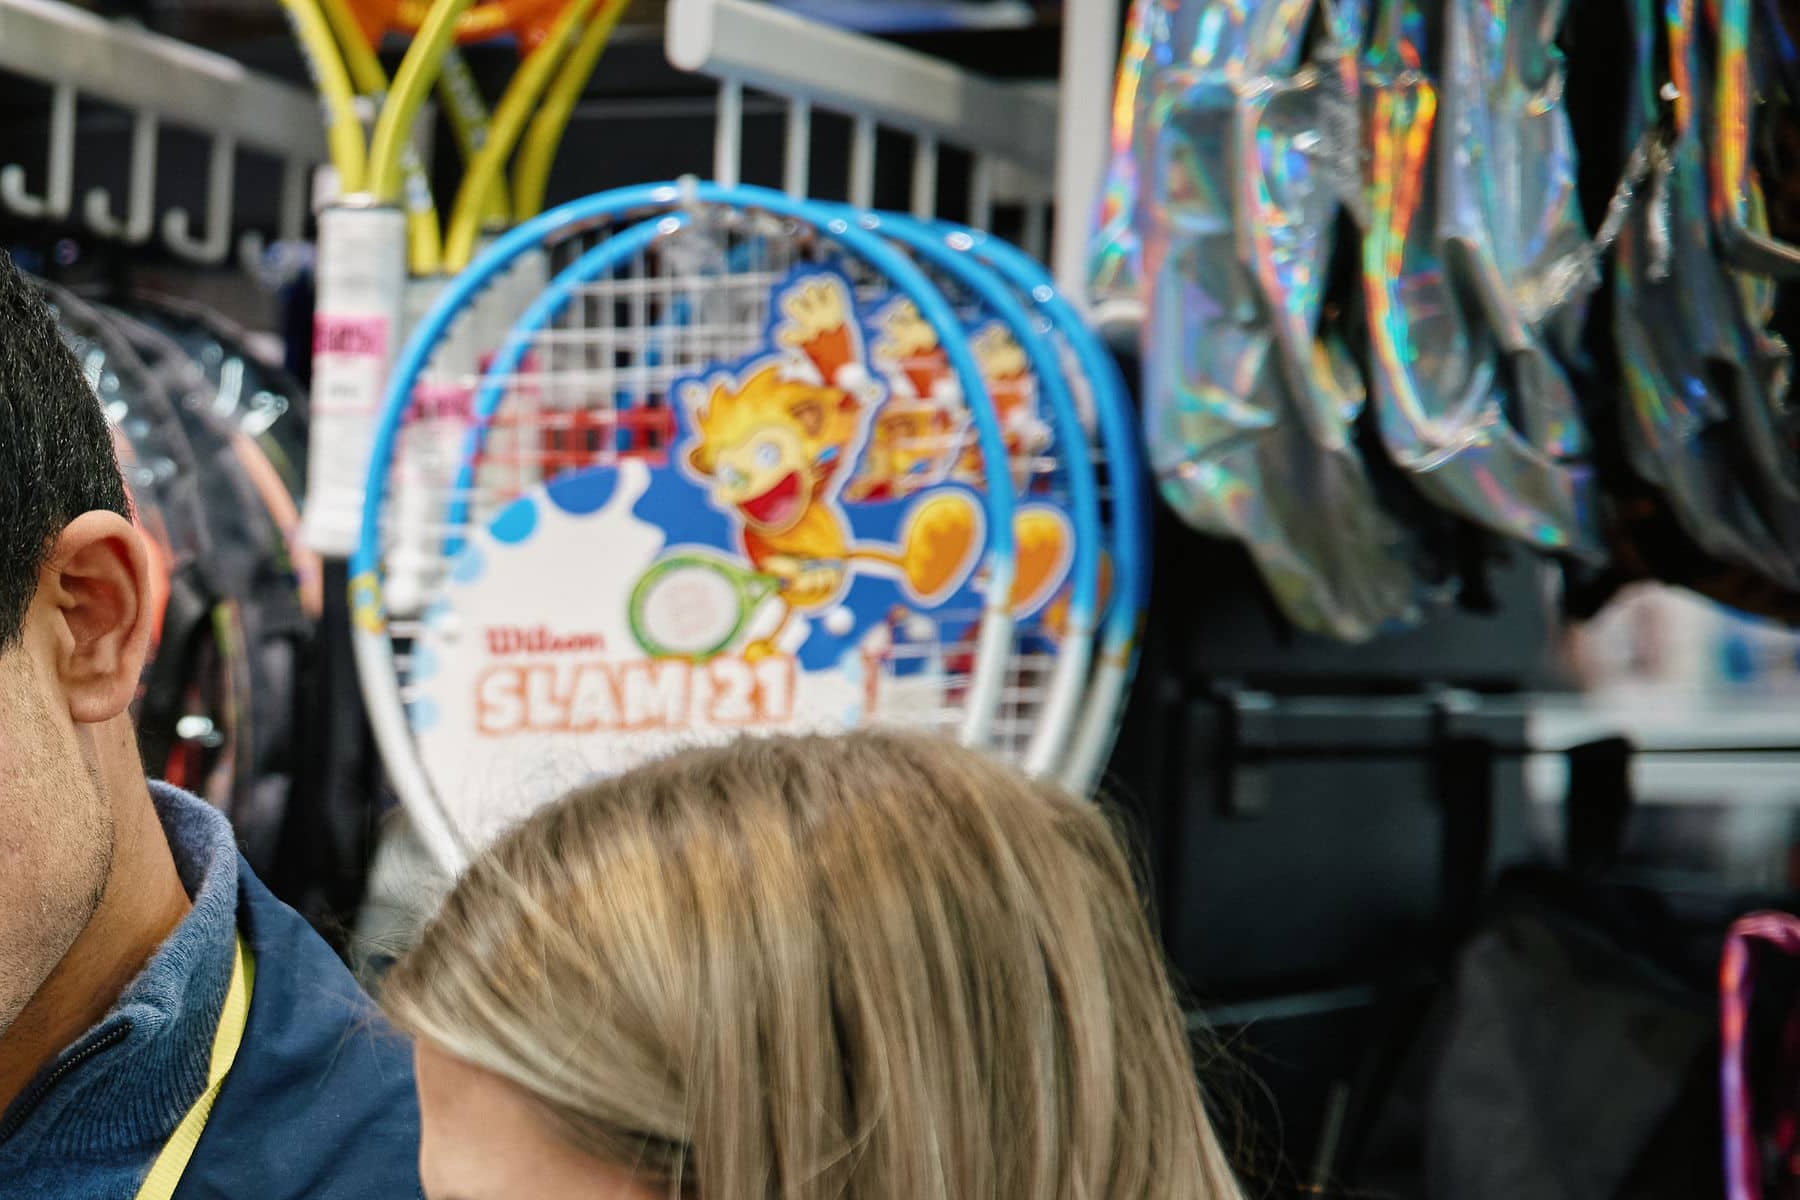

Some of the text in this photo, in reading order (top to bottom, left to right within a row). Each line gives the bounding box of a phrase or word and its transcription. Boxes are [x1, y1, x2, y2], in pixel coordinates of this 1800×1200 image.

[486, 625, 604, 655] Wilson
[472, 653, 797, 737] SLAM 21
